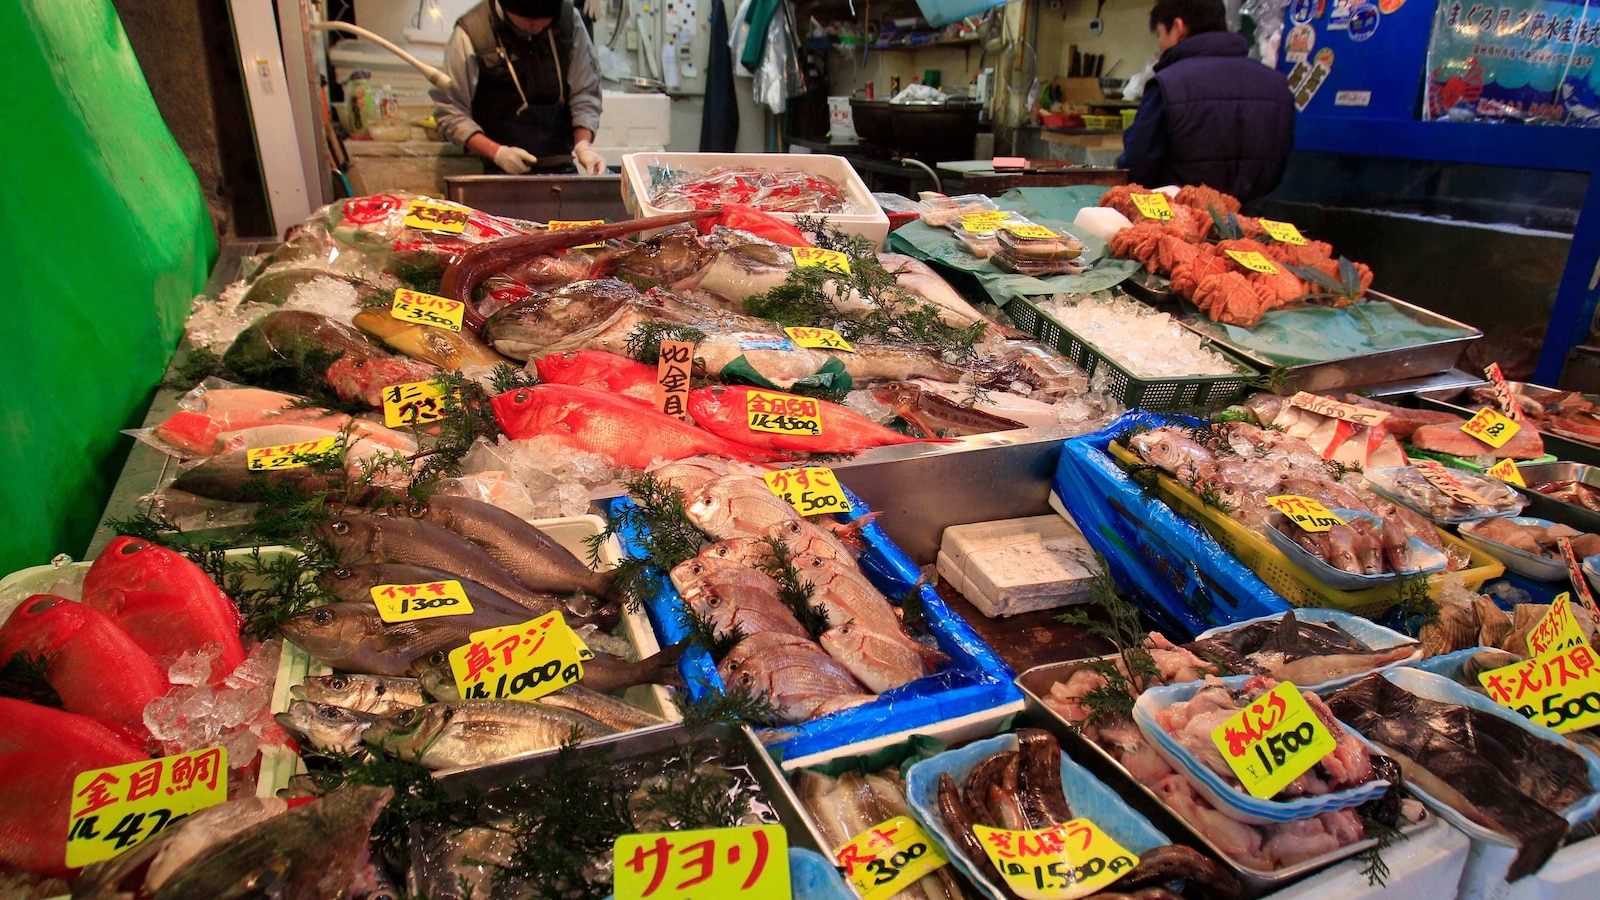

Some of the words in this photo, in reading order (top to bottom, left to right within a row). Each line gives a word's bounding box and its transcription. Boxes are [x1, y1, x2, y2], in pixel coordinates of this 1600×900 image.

[797, 248, 839, 262] 真タラ
[400, 291, 461, 313] きじハタ
[792, 327, 835, 341] 真タラ
[385, 385, 423, 403] オニ
[659, 345, 690, 421] 地金目
[747, 393, 817, 417] 金目鯛
[380, 583, 447, 598] イサキ
[463, 616, 556, 683] 真アジ
[73, 748, 221, 820] 金目鯛
[624, 829, 770, 898] サヨリ
